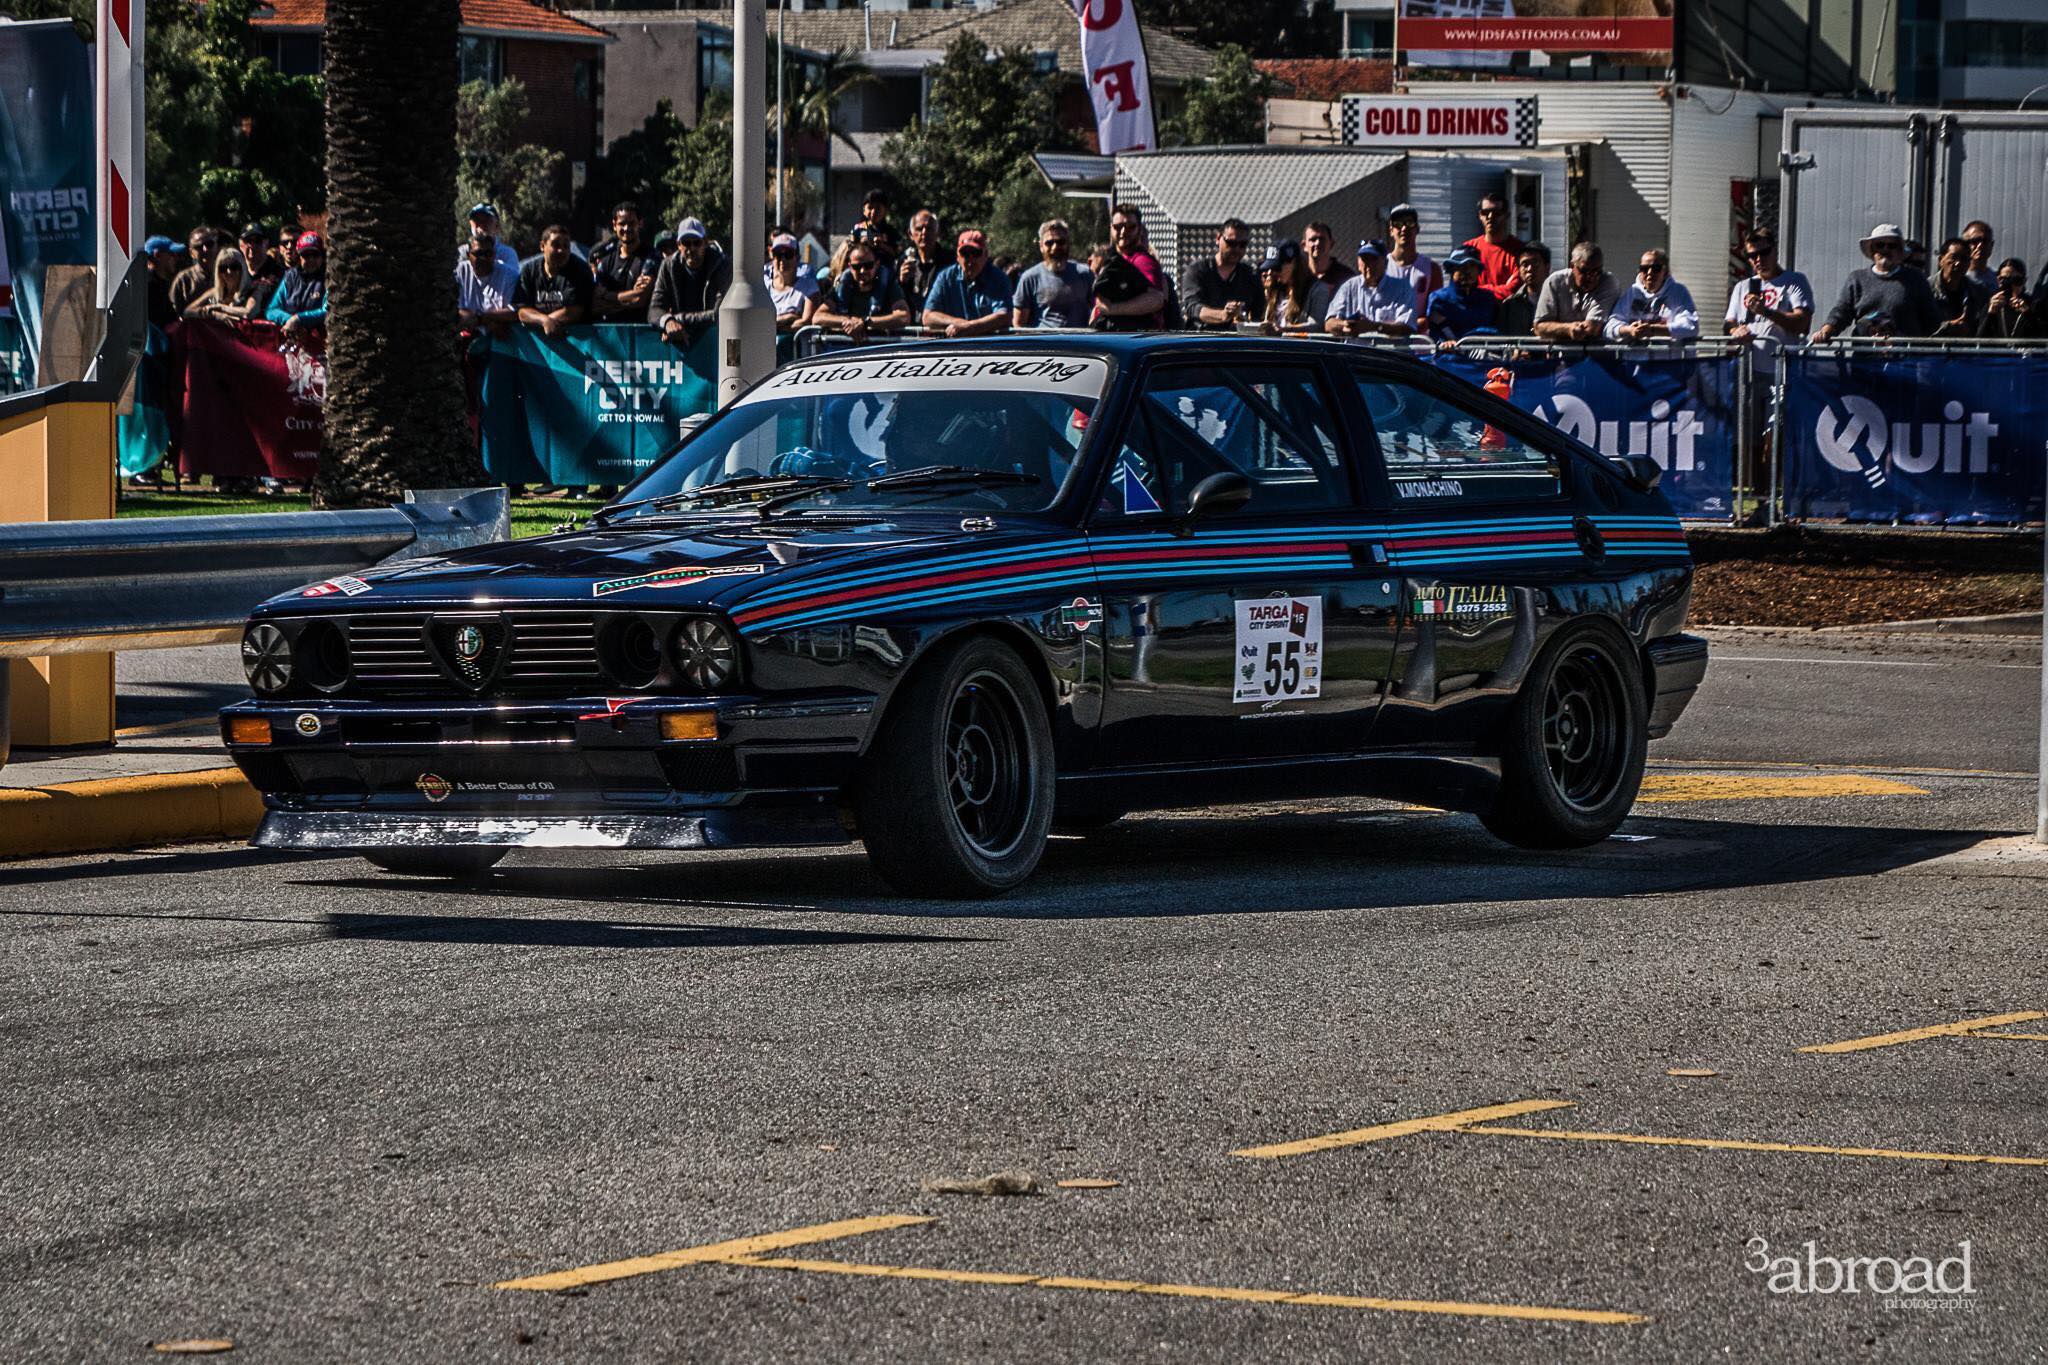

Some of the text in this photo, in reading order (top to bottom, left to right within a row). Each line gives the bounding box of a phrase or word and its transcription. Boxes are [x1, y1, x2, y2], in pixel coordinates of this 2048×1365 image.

[1444, 29, 1621, 41] WWW.JDSFASTFOODS.COM.AU
[1365, 107, 1509, 136] COLD DRINKS
[585, 360, 684, 395] PERTH
[772, 358, 1089, 388] Auto Italia racing
[599, 386, 667, 410] CITY
[598, 413, 665, 422] GET TO KNOW ME
[1816, 395, 1999, 489] Quit
[1396, 481, 1463, 498] V.MONACHINO
[599, 577, 646, 591] Auto
[652, 570, 704, 582] Italia
[1414, 585, 1507, 613] AUTO ITALIA
[1249, 605, 1290, 620] TARGA
[1456, 603, 1508, 613] 9375 2552
[1249, 620, 1290, 630] CITY SPRINT
[1241, 645, 1258, 659] Quit
[1264, 640, 1301, 697] 55
[415, 781, 454, 790] PENRITE
[456, 780, 556, 790] A Better Class of Oil
